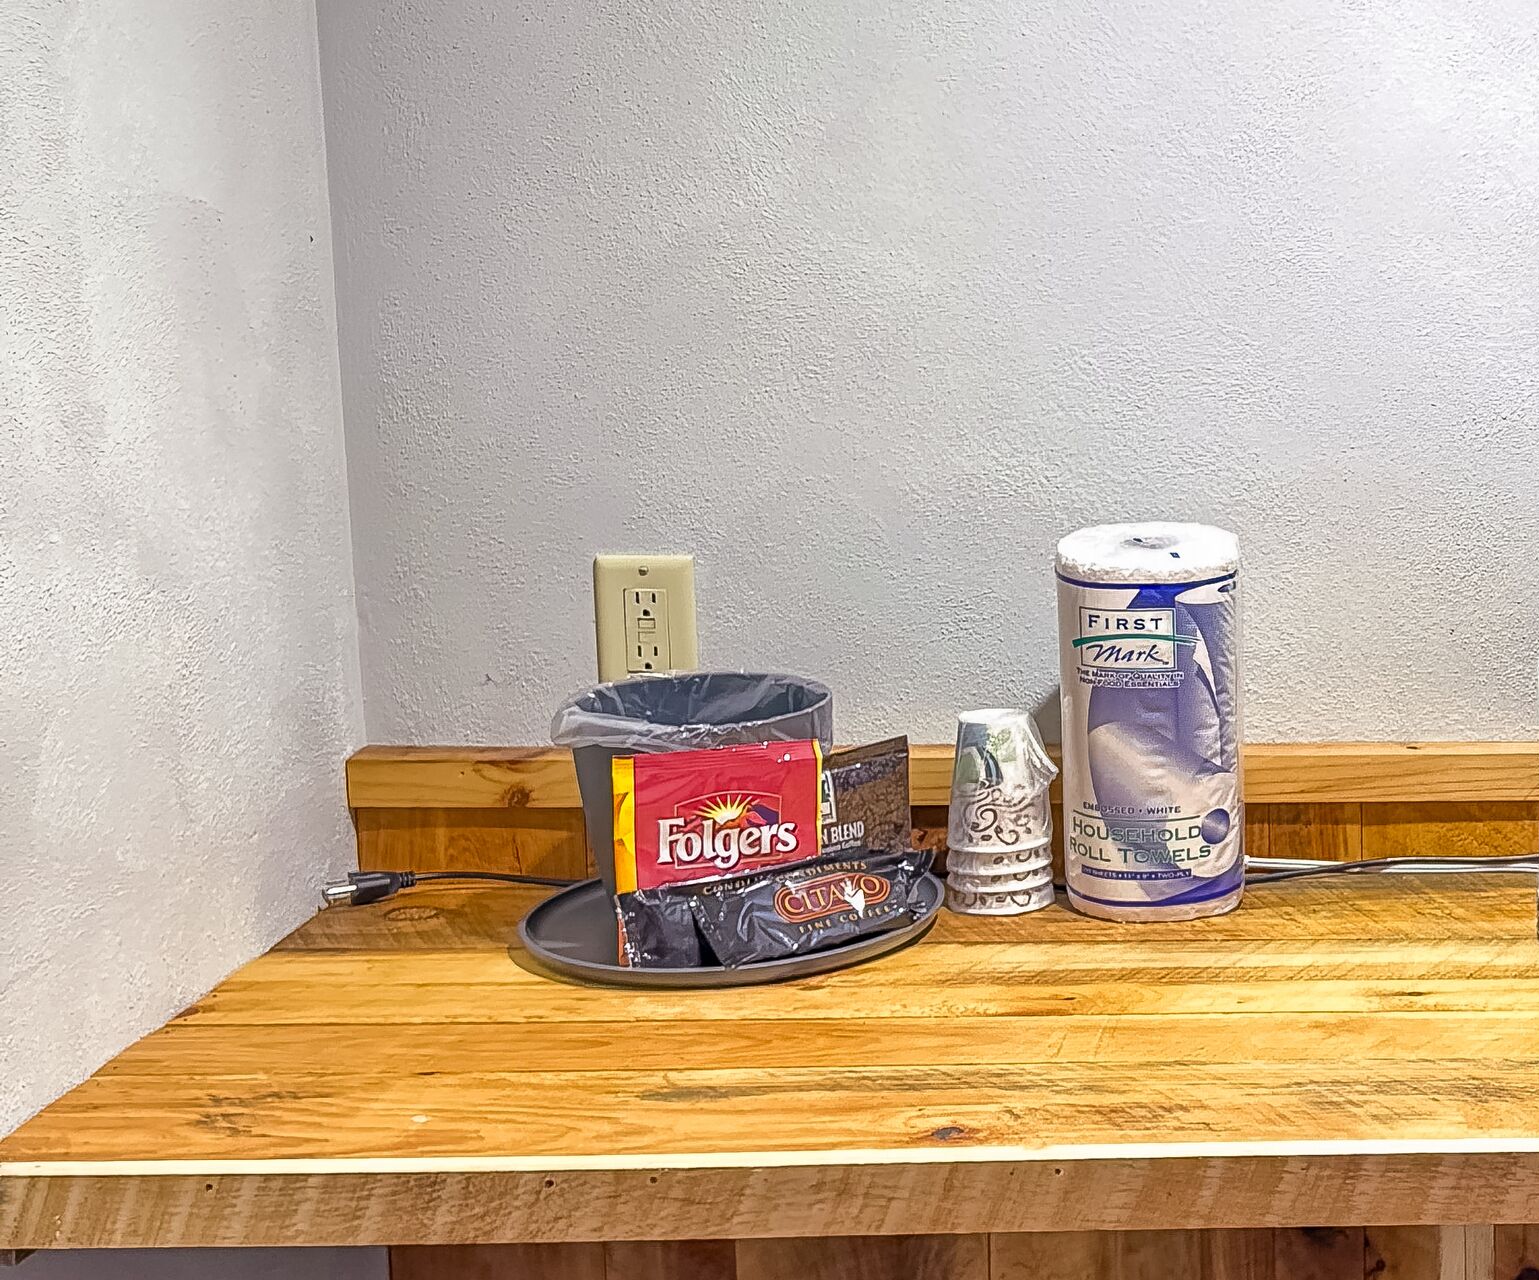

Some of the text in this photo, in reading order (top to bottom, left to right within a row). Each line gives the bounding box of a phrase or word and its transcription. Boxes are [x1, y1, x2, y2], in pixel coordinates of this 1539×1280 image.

[1088, 614, 1163, 630] FIRST
[1086, 644, 1165, 663] Mark
[1077, 667, 1090, 677] THE
[1092, 669, 1116, 680] MARK
[1117, 672, 1130, 681] OF
[1132, 671, 1171, 682] QUALITY
[1124, 679, 1180, 689] ESSENTIALS
[1083, 801, 1181, 815] EMBOSSED WHITE
[831, 820, 865, 843] BLEND
[1073, 816, 1201, 842] HOUSEHOLD
[656, 817, 798, 869] Folgers
[1069, 836, 1212, 864] ROLL TOWELS
[799, 919, 832, 934] FINE
